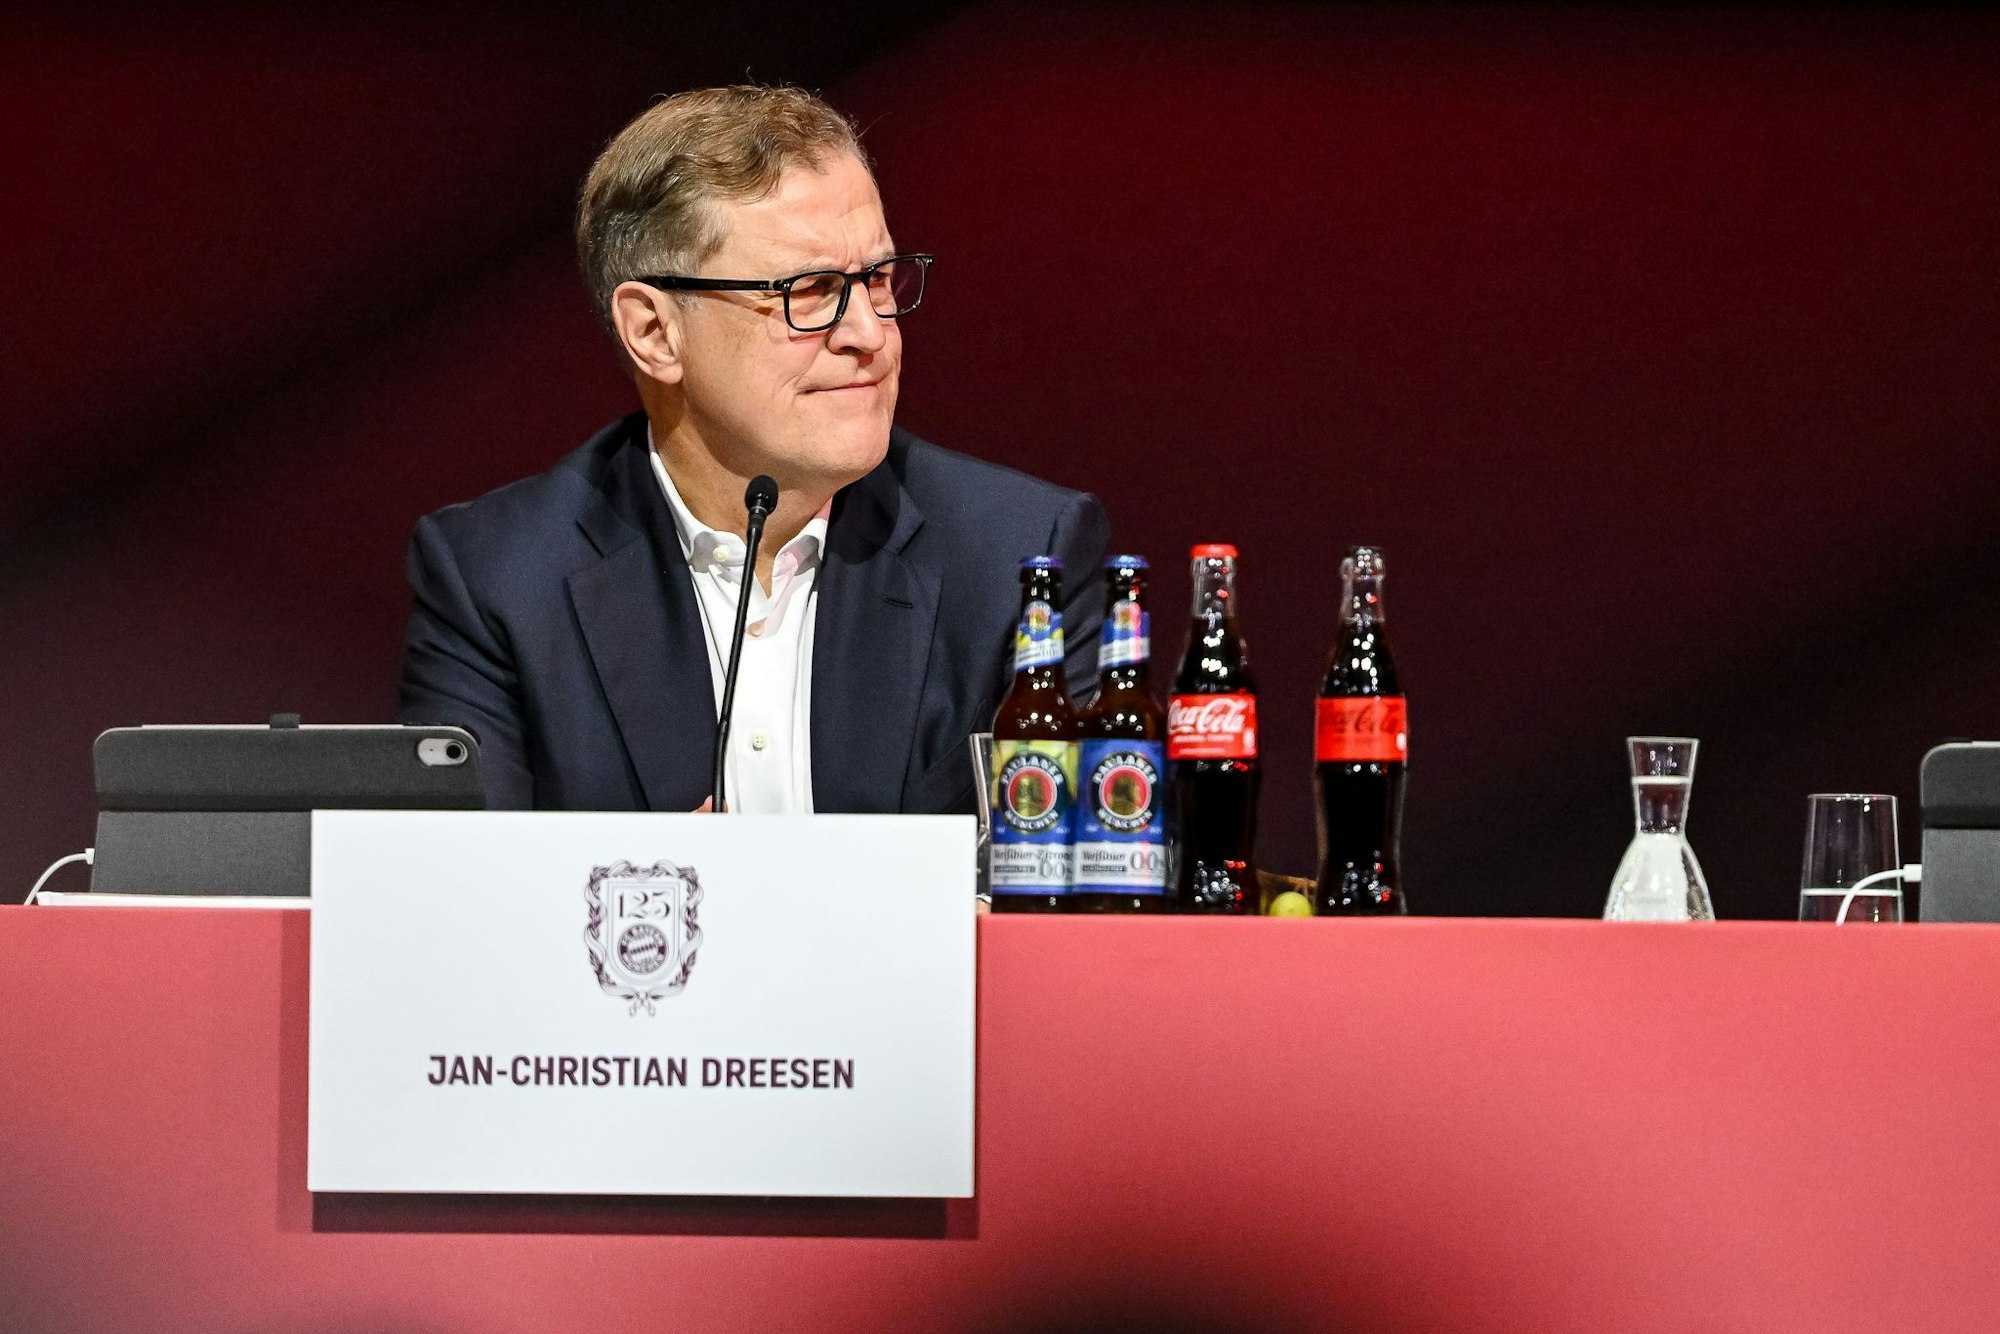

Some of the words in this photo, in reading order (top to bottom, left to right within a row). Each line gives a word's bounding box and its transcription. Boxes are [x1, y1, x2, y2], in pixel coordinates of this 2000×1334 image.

[618, 891, 671, 919] 125
[427, 1054, 688, 1087] JAN-CHRISTIAN
[702, 1057, 855, 1090] DREESEN
